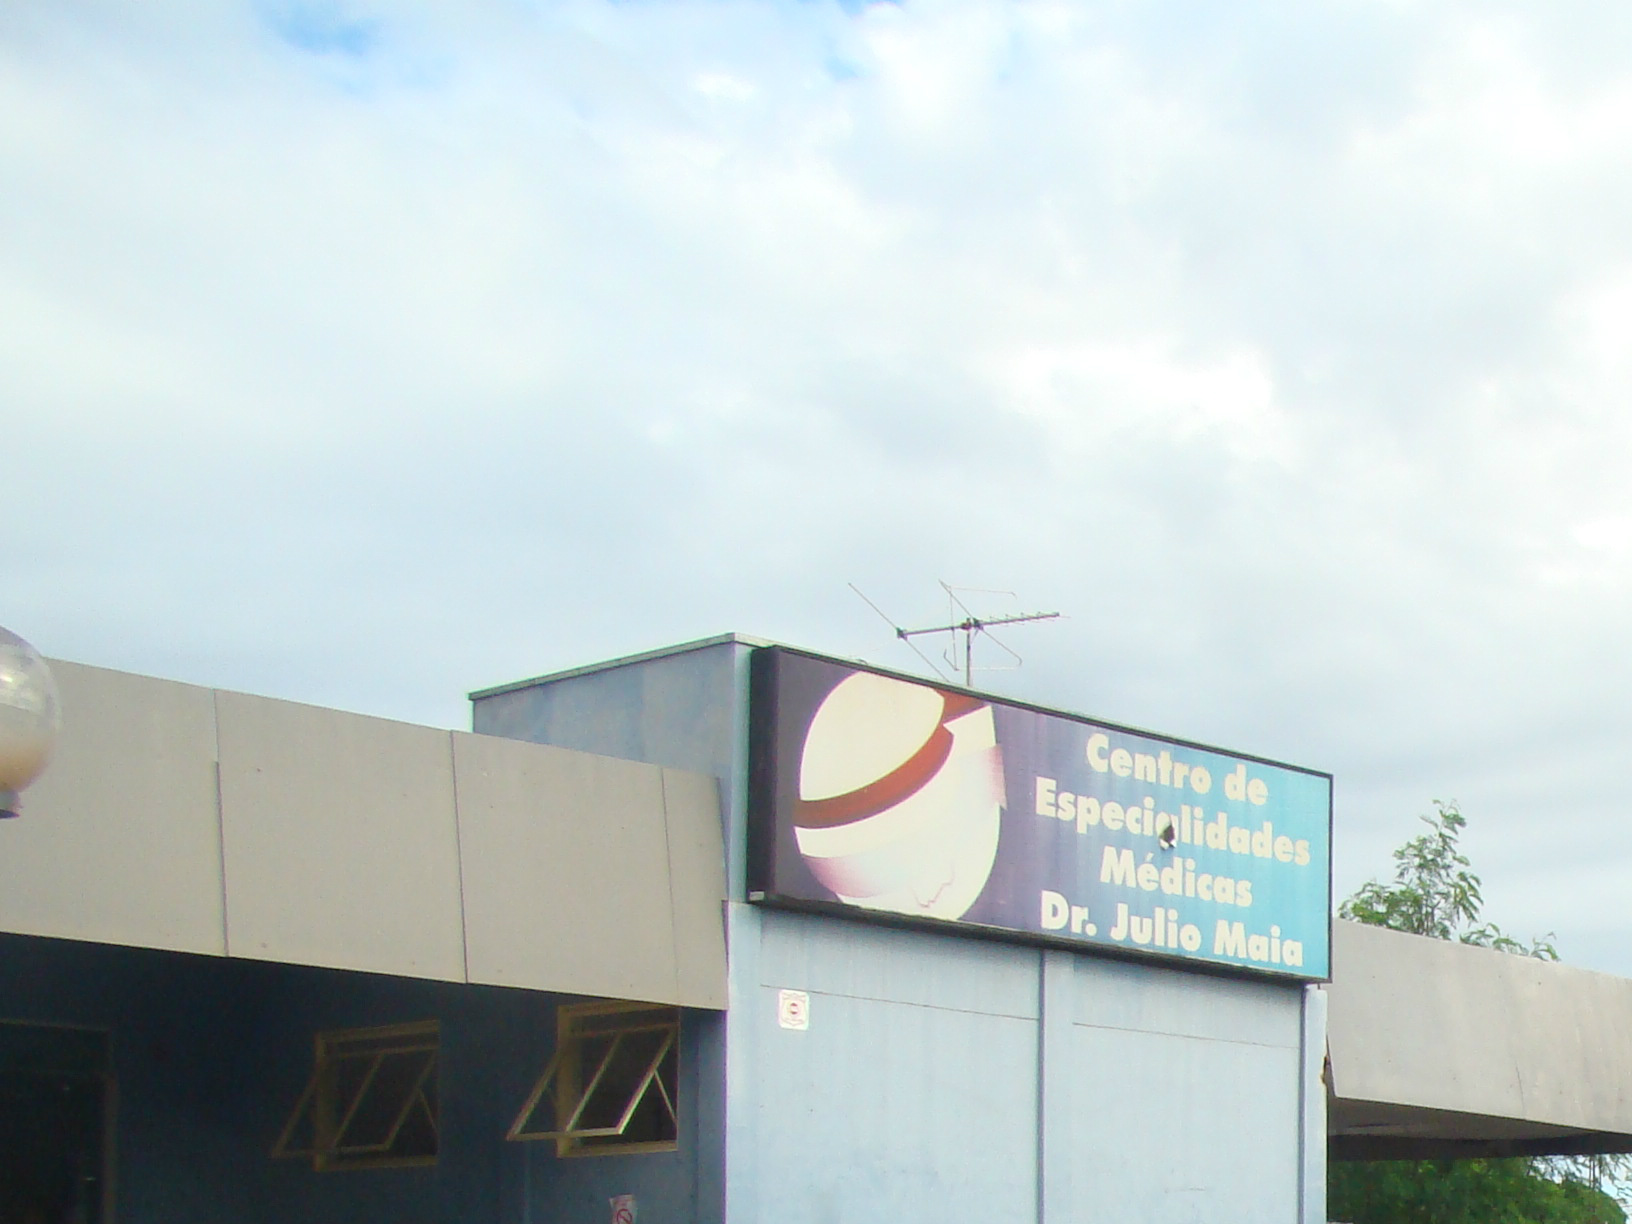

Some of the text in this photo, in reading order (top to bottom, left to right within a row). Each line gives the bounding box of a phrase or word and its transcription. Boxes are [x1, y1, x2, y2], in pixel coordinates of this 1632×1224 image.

[1086, 733, 1269, 806] Centro de
[1100, 845, 1253, 907] Médicas
[1040, 890, 1304, 967] Dr. Julio Maia
